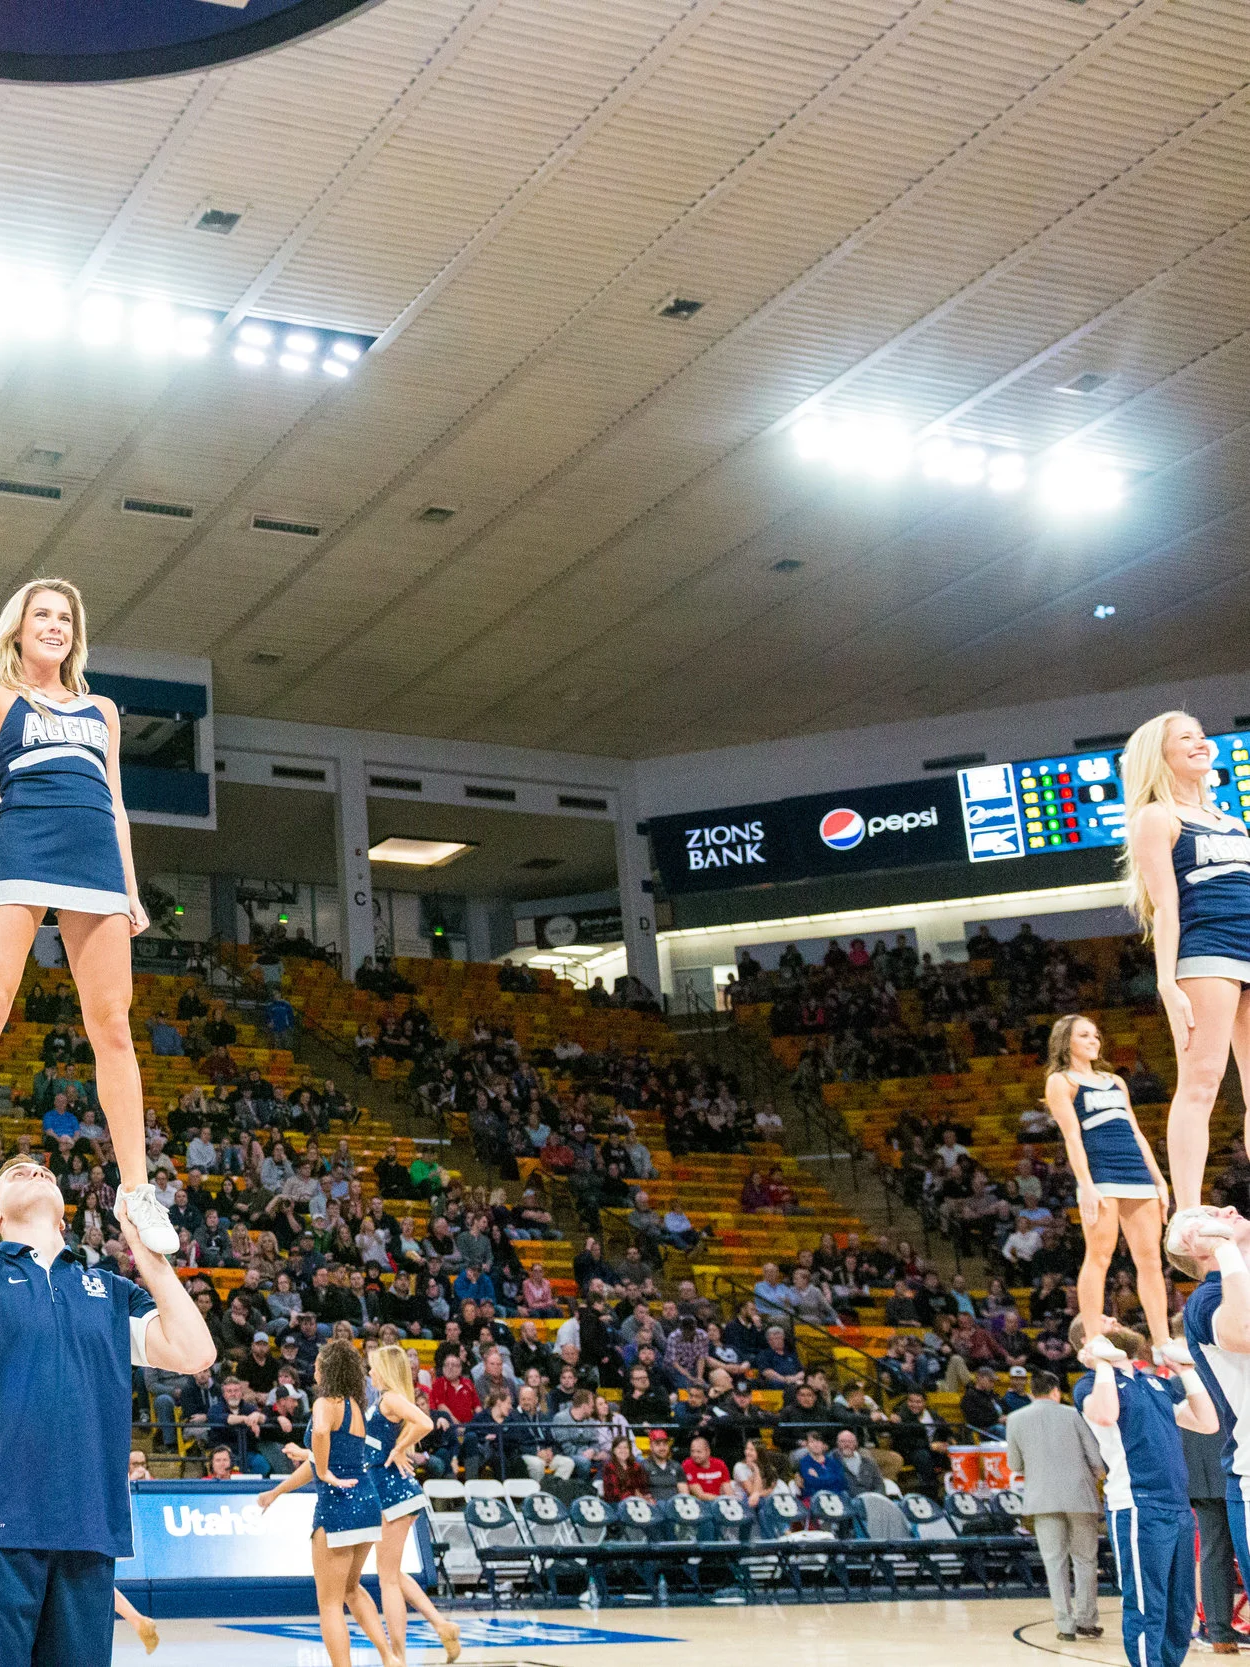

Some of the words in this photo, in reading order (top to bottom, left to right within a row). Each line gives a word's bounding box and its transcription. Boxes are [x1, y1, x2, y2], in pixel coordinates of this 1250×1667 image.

[22, 713, 109, 756] AGGIES
[685, 821, 765, 848] ZIONS
[868, 806, 939, 838] pepsi
[688, 843, 767, 870] BANK
[354, 891, 367, 907] C
[639, 916, 650, 931] D
